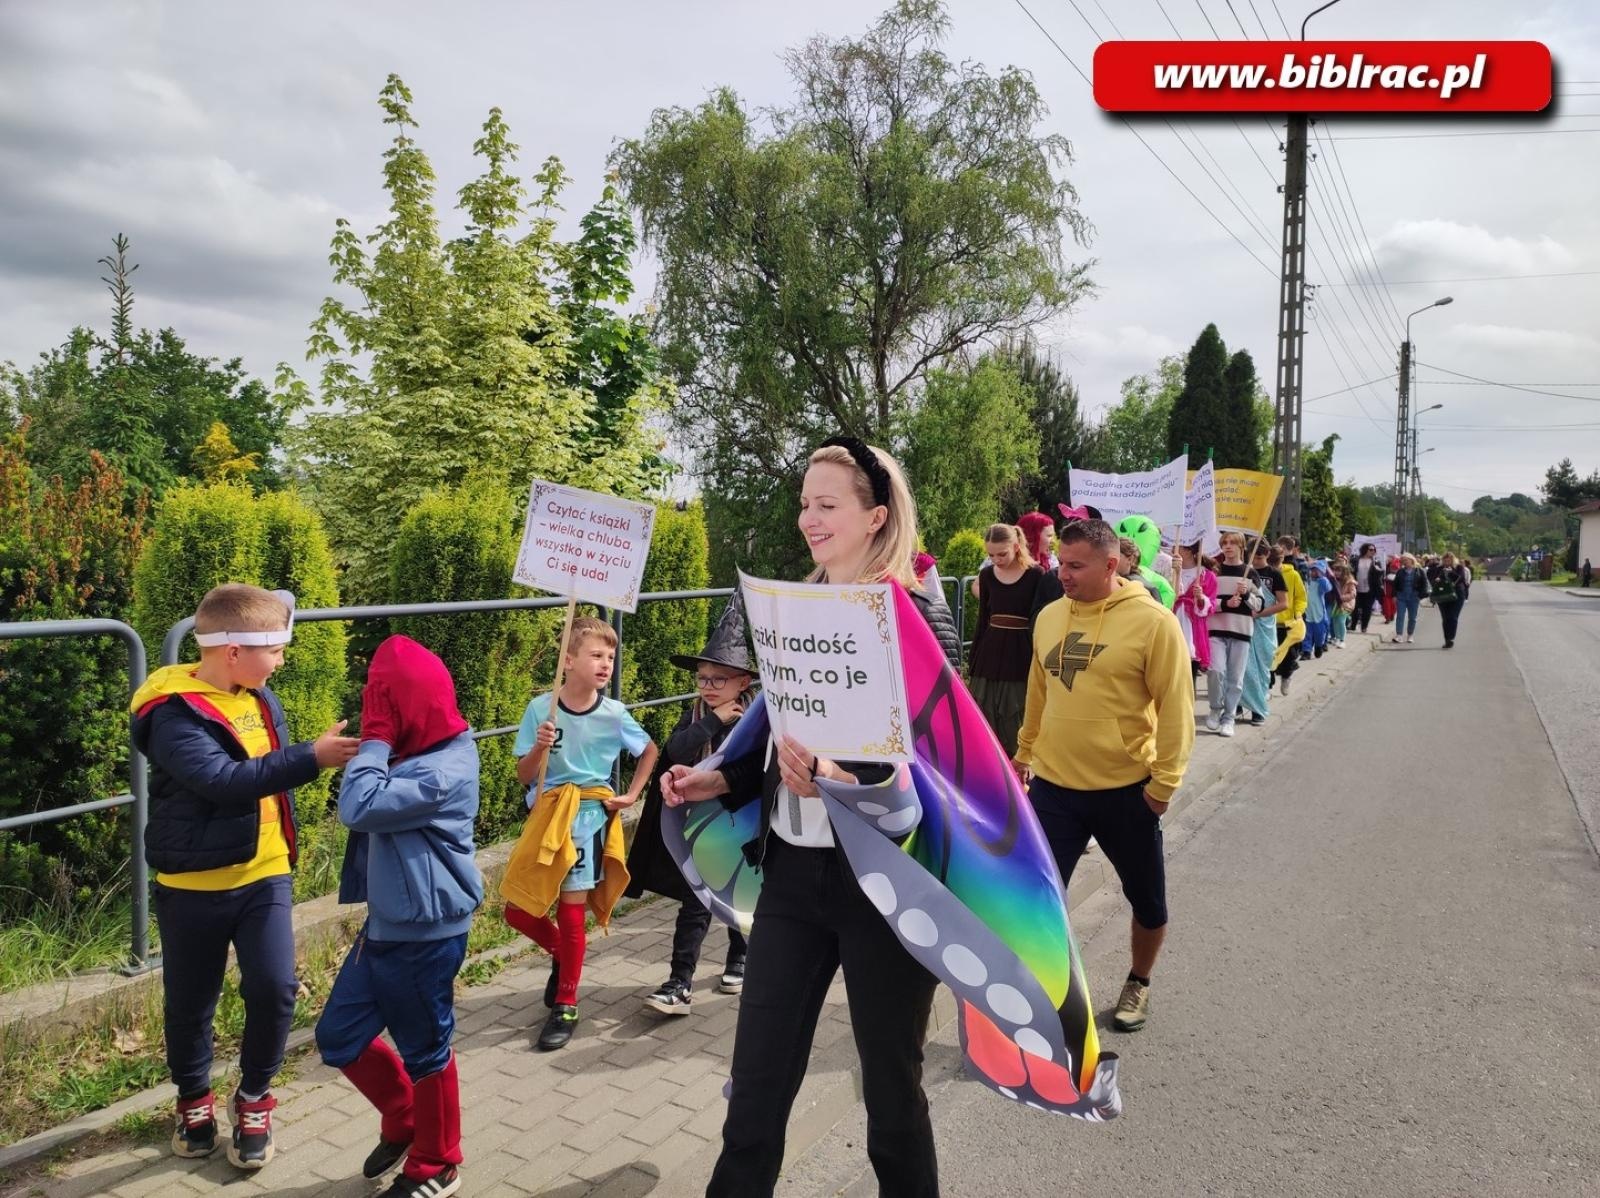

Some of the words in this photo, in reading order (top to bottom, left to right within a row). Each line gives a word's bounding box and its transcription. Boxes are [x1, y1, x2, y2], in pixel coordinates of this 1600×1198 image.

[547, 501, 586, 520] Czytać
[590, 511, 630, 531] książki
[549, 522, 584, 538] wielka
[587, 531, 633, 551] chluba,
[535, 537, 582, 556] wszystko
[586, 550, 596, 559] w
[599, 551, 631, 569] życiu
[547, 557, 559, 569] Ci
[561, 561, 578, 576] się
[581, 567, 609, 582] uda!
[782, 633, 857, 654] radość
[766, 658, 803, 685] tym,
[810, 669, 838, 684] co
[846, 665, 867, 689] je
